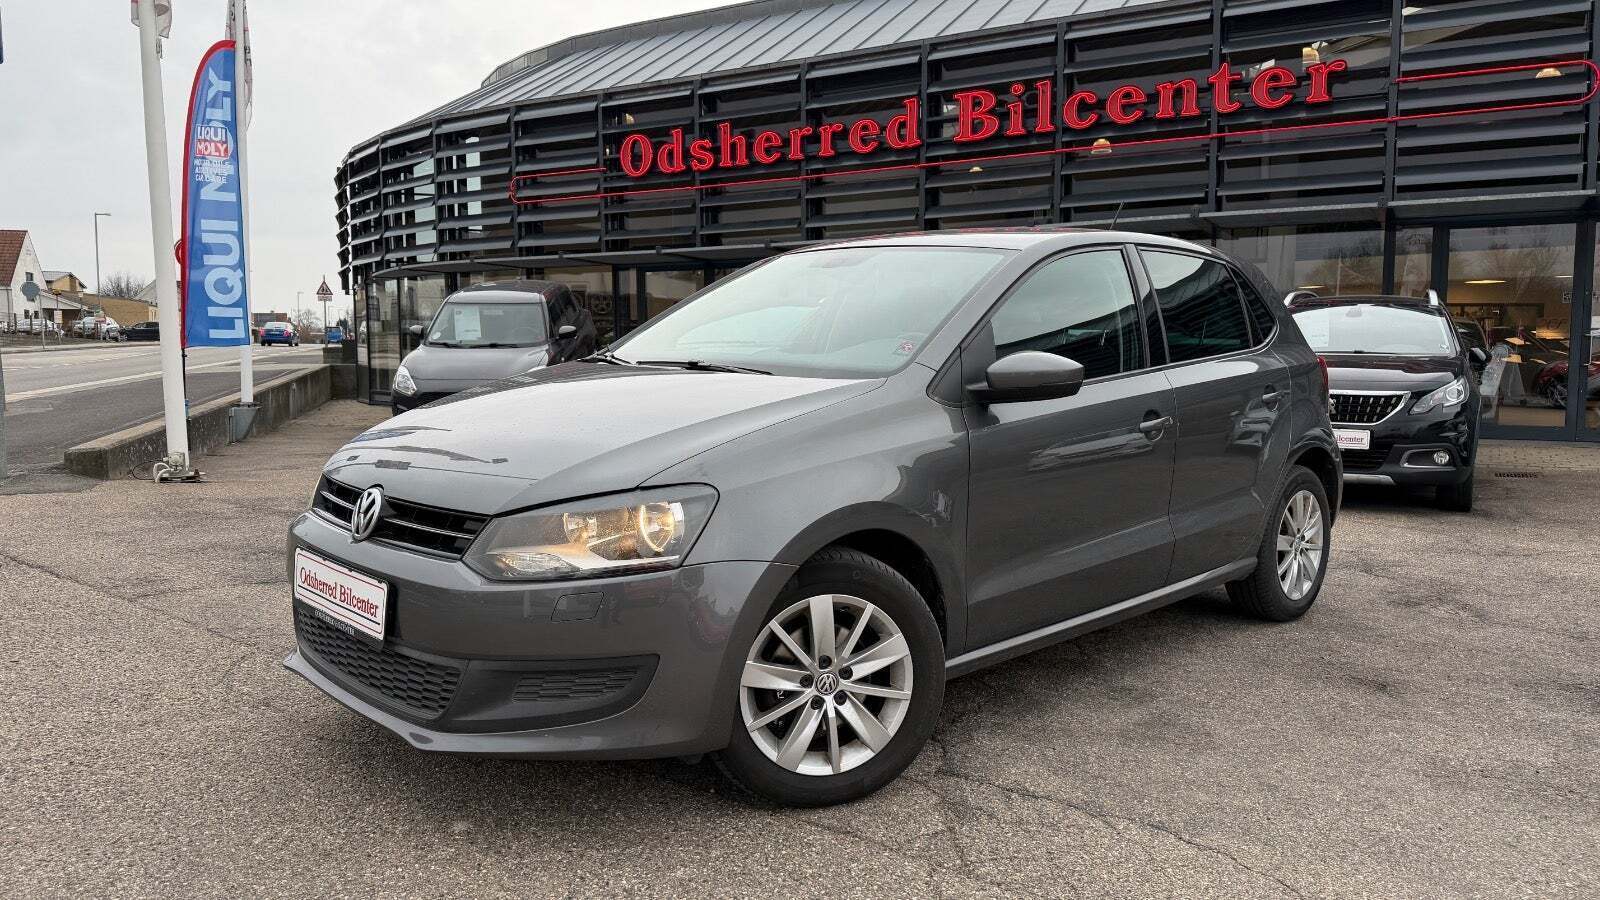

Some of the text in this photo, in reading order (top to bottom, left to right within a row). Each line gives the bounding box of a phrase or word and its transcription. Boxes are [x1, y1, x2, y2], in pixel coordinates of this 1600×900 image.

[197, 126, 226, 141] LIQUI
[618, 59, 1347, 178] Odsherred Bilcenter
[196, 141, 227, 156] MOLY
[201, 219, 246, 339] LIQUI
[1336, 435, 1364, 443] ilcenter
[300, 566, 379, 618] Odsherred Bilcenter
